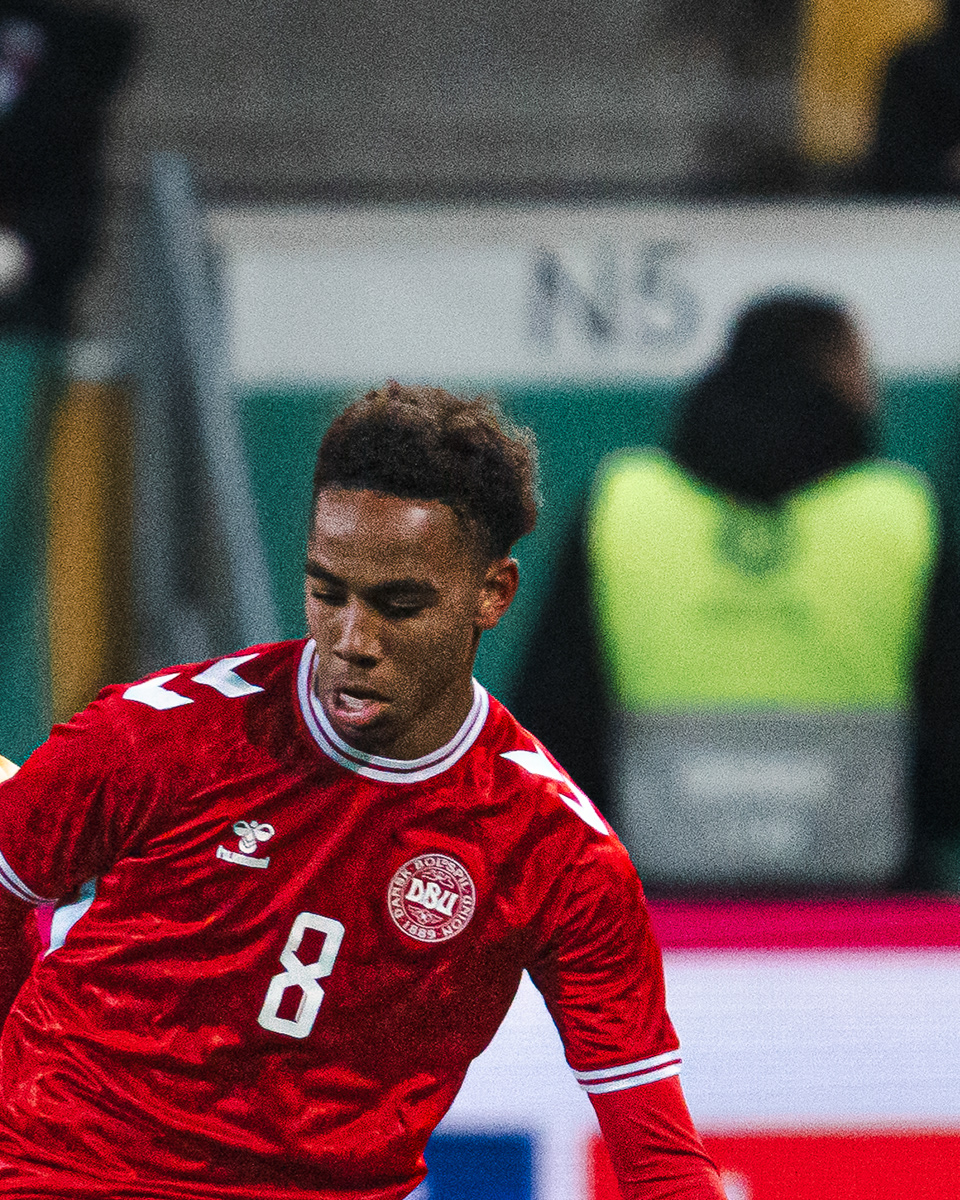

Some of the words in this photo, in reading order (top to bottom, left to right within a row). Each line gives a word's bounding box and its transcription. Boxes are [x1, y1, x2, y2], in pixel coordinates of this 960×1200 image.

[524, 240, 700, 350] N5
[405, 877, 460, 917] DBU
[257, 911, 346, 1040] 8
